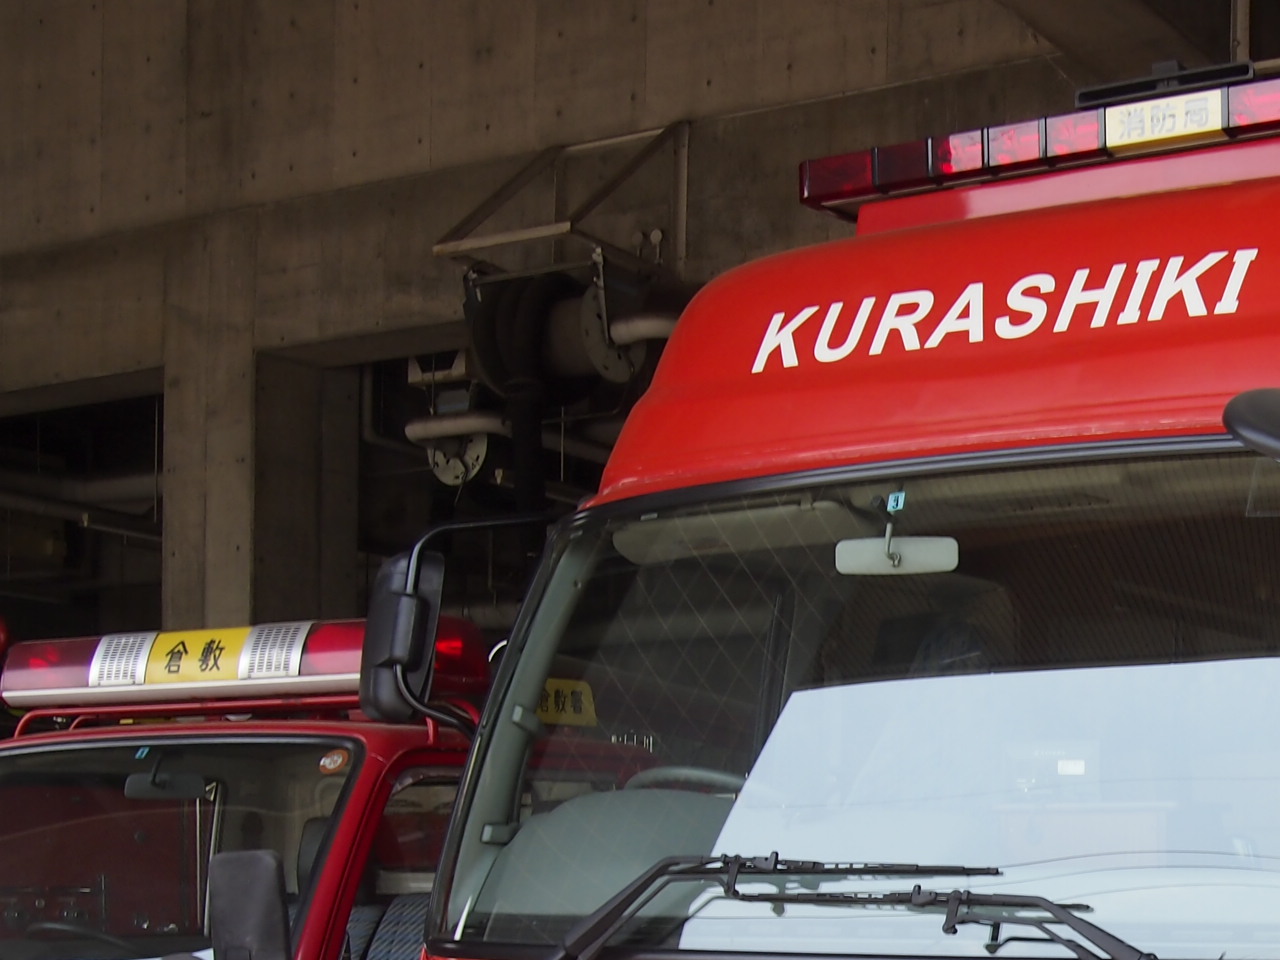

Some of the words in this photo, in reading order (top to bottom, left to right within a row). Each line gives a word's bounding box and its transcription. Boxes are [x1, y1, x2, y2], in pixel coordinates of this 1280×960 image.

[1118, 97, 1210, 141] 消防局
[751, 248, 1259, 374] KURASHIKI
[165, 639, 226, 675] 倉敷
